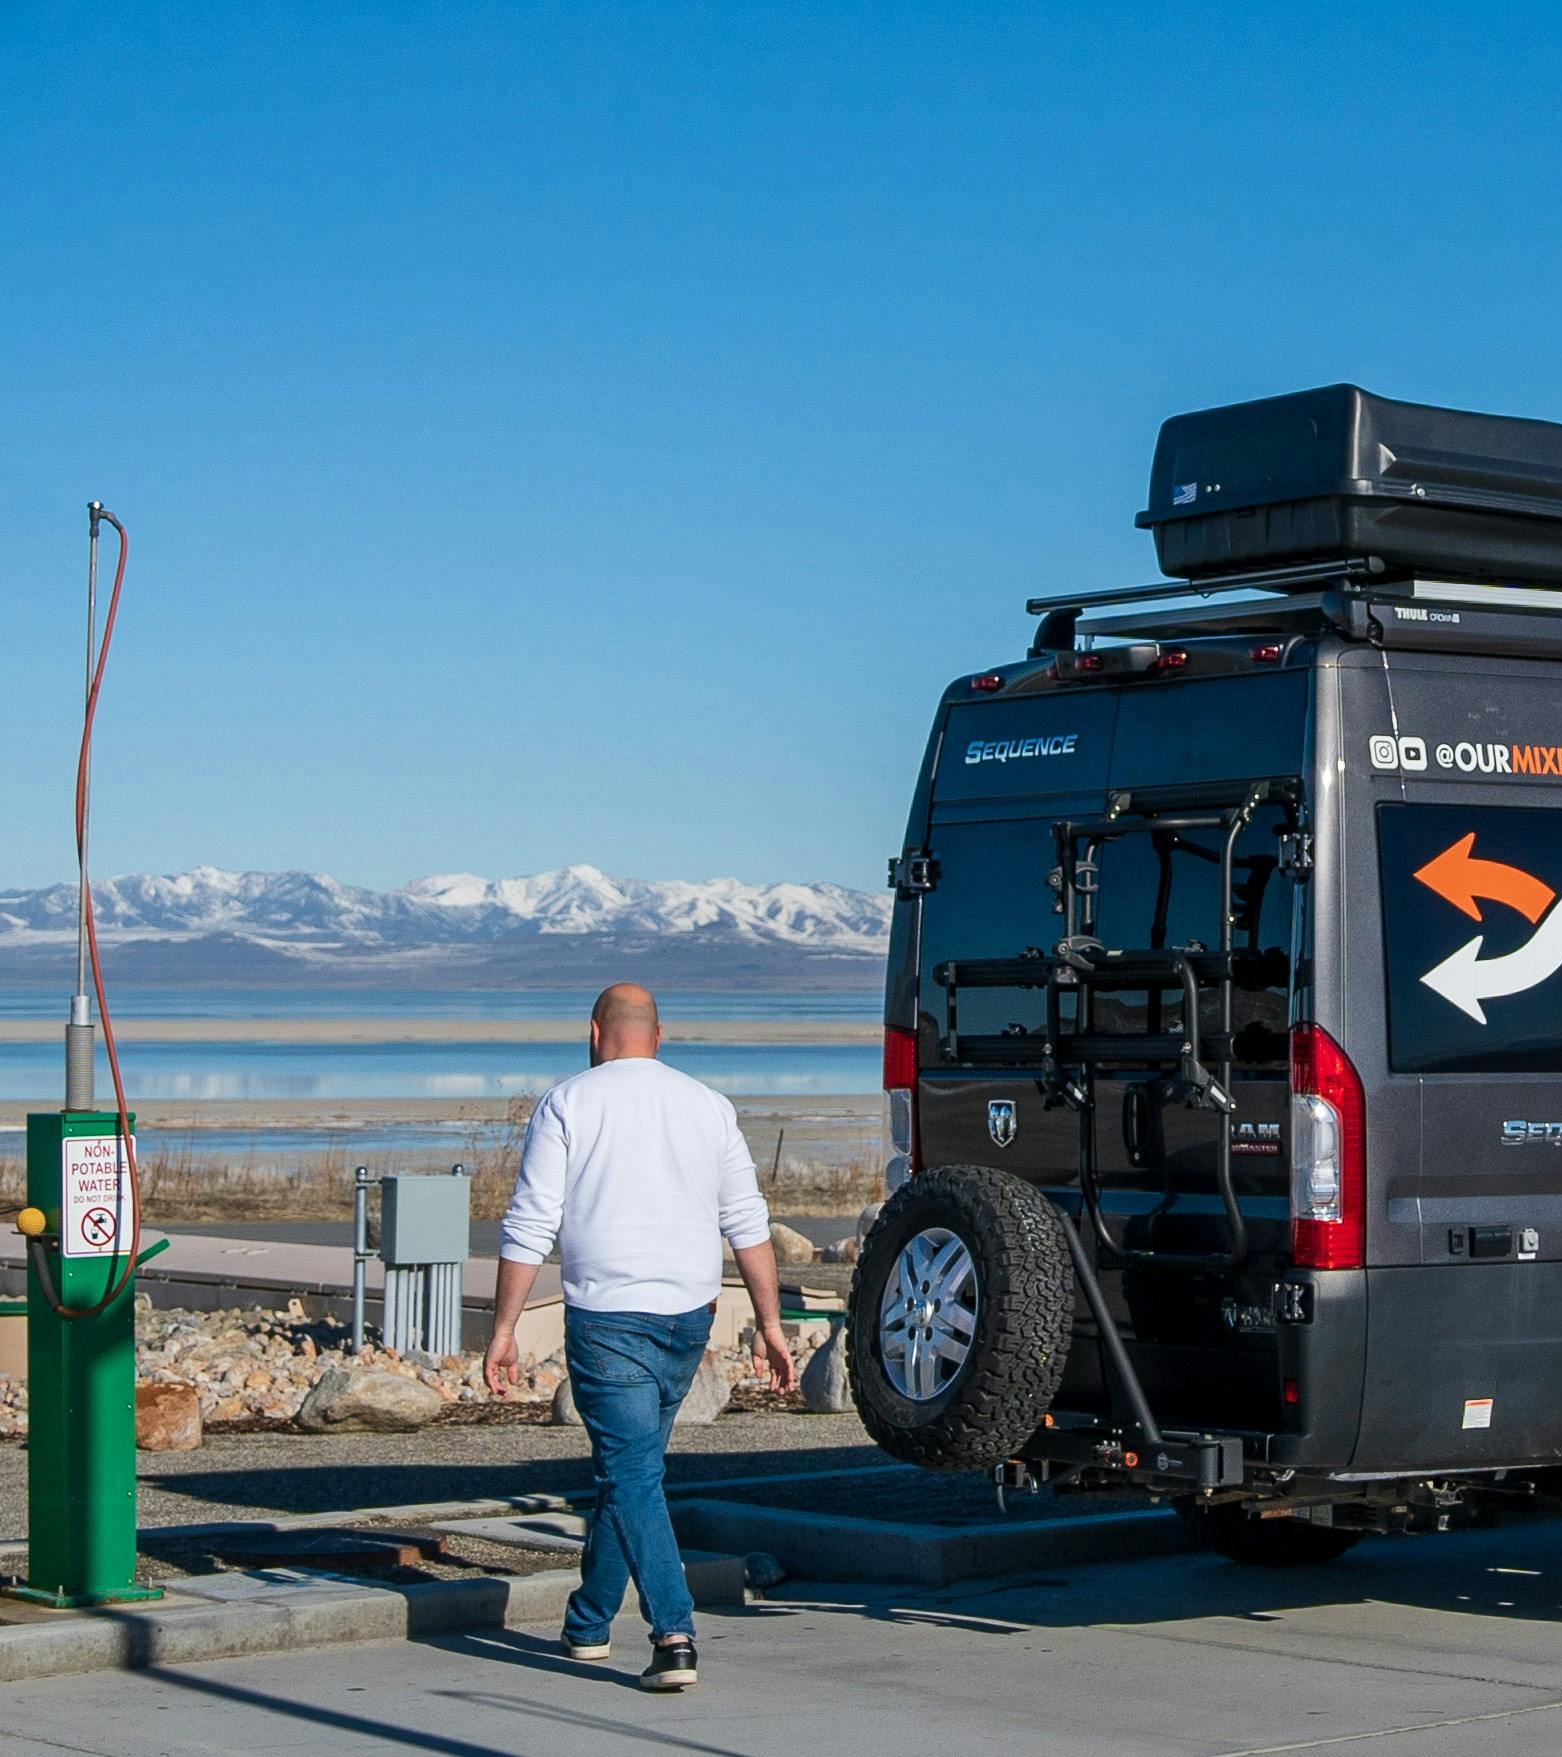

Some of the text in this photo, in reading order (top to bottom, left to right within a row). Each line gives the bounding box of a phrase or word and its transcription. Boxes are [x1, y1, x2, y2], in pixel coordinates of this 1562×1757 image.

[1394, 607, 1428, 621] THULE
[84, 1145, 115, 1158] NON-
[71, 1161, 128, 1175] POTABLE
[78, 1178, 121, 1192] WATER
[73, 1195, 85, 1204] DO
[86, 1195, 103, 1203] NOT
